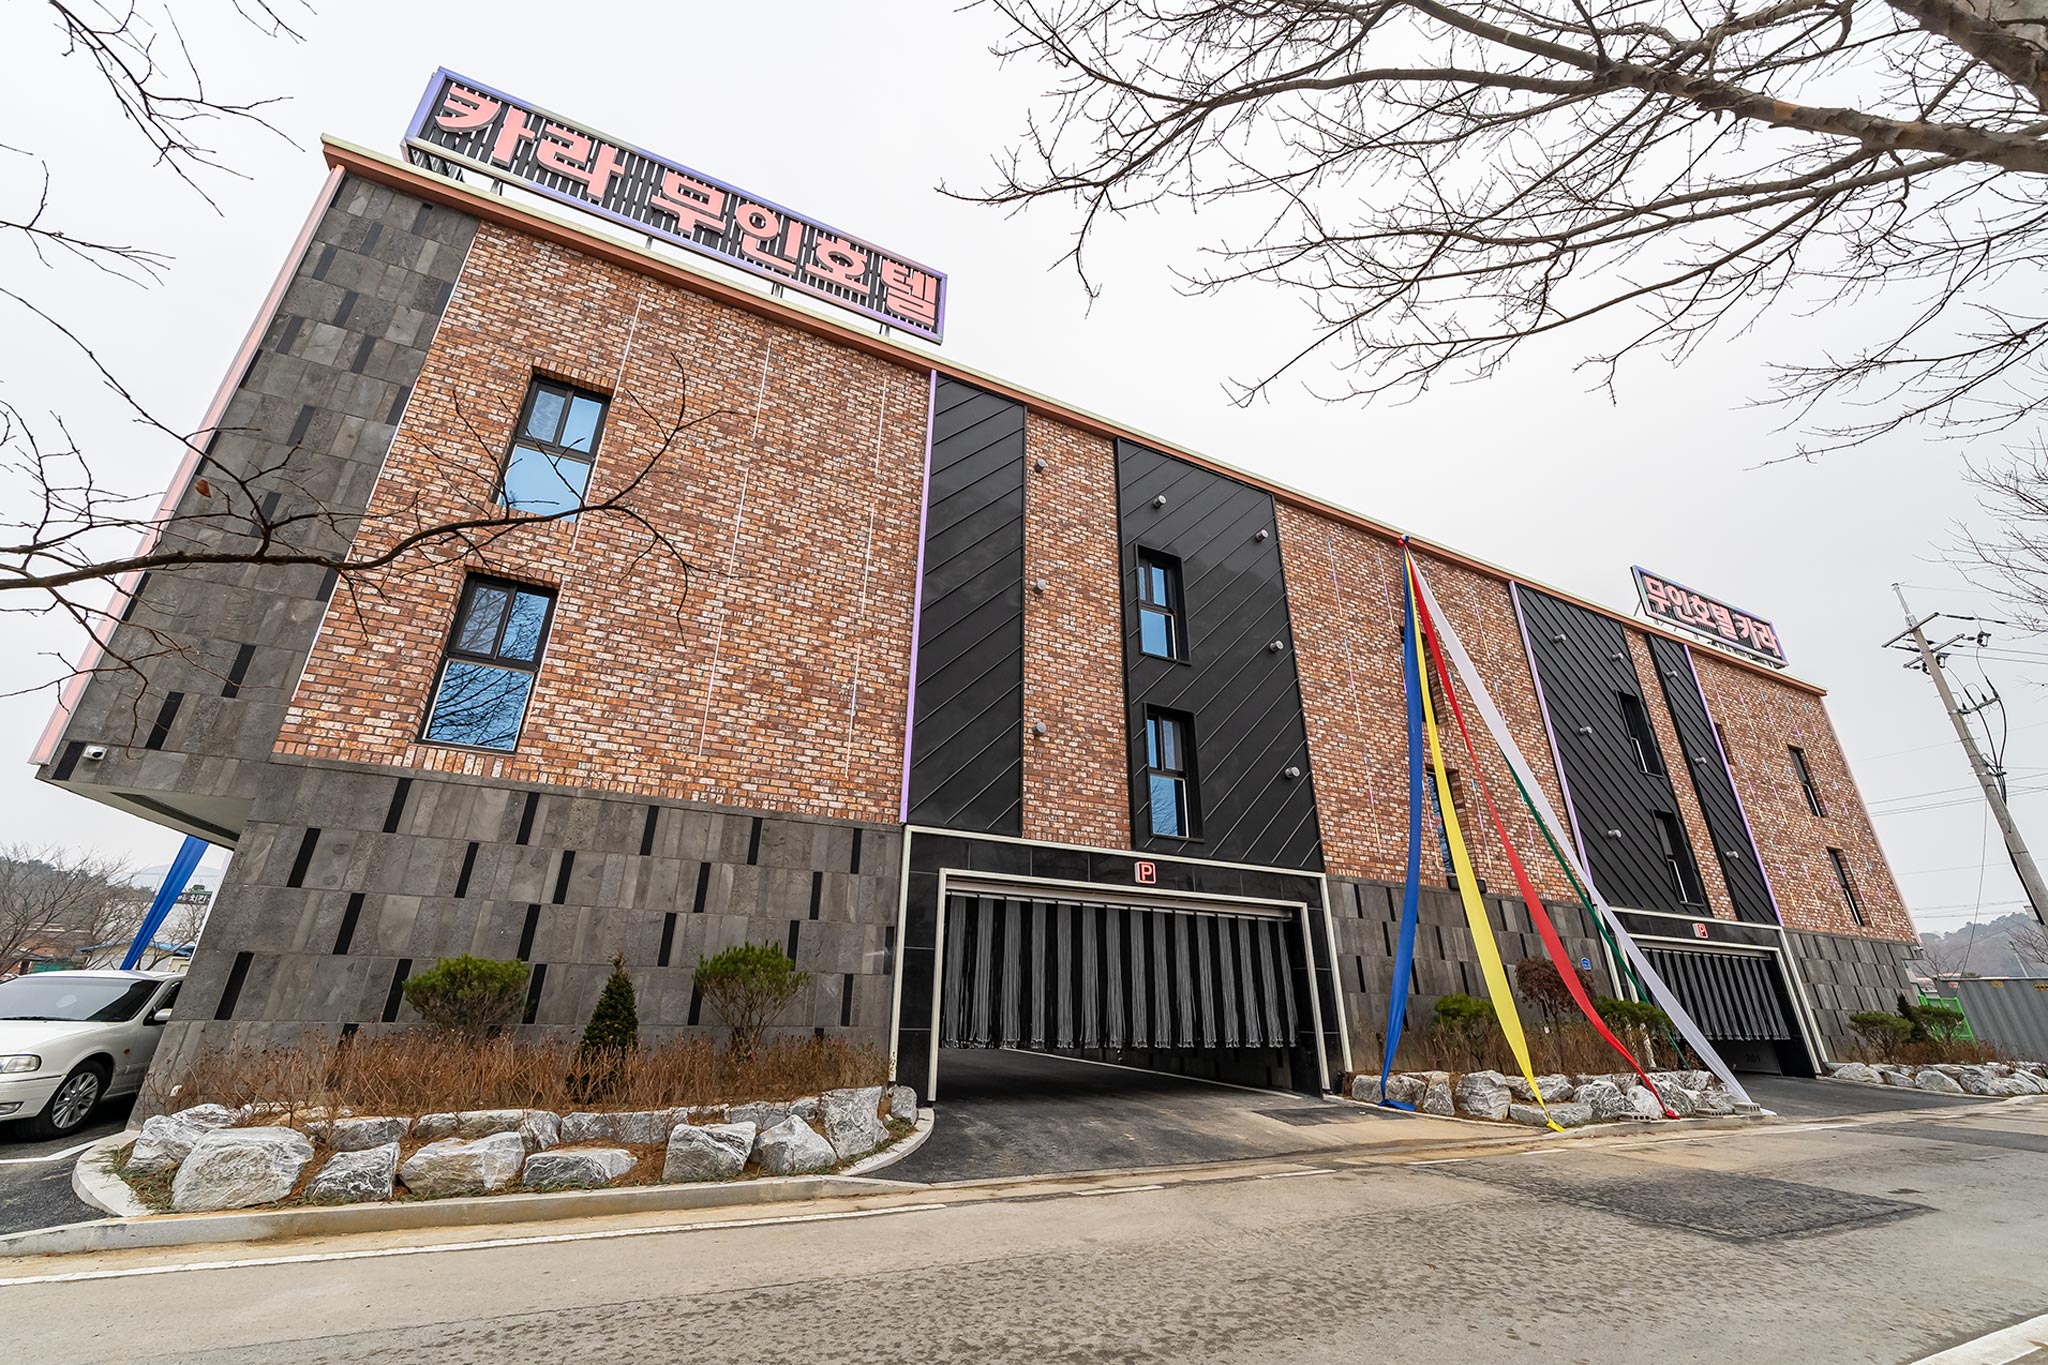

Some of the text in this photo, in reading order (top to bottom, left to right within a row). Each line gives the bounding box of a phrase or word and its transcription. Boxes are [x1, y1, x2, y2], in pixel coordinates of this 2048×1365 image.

[434, 82, 938, 330] 카라 무인호텔
[1643, 575, 1782, 658] 무인호텔 카라
[1141, 864, 1153, 881] P
